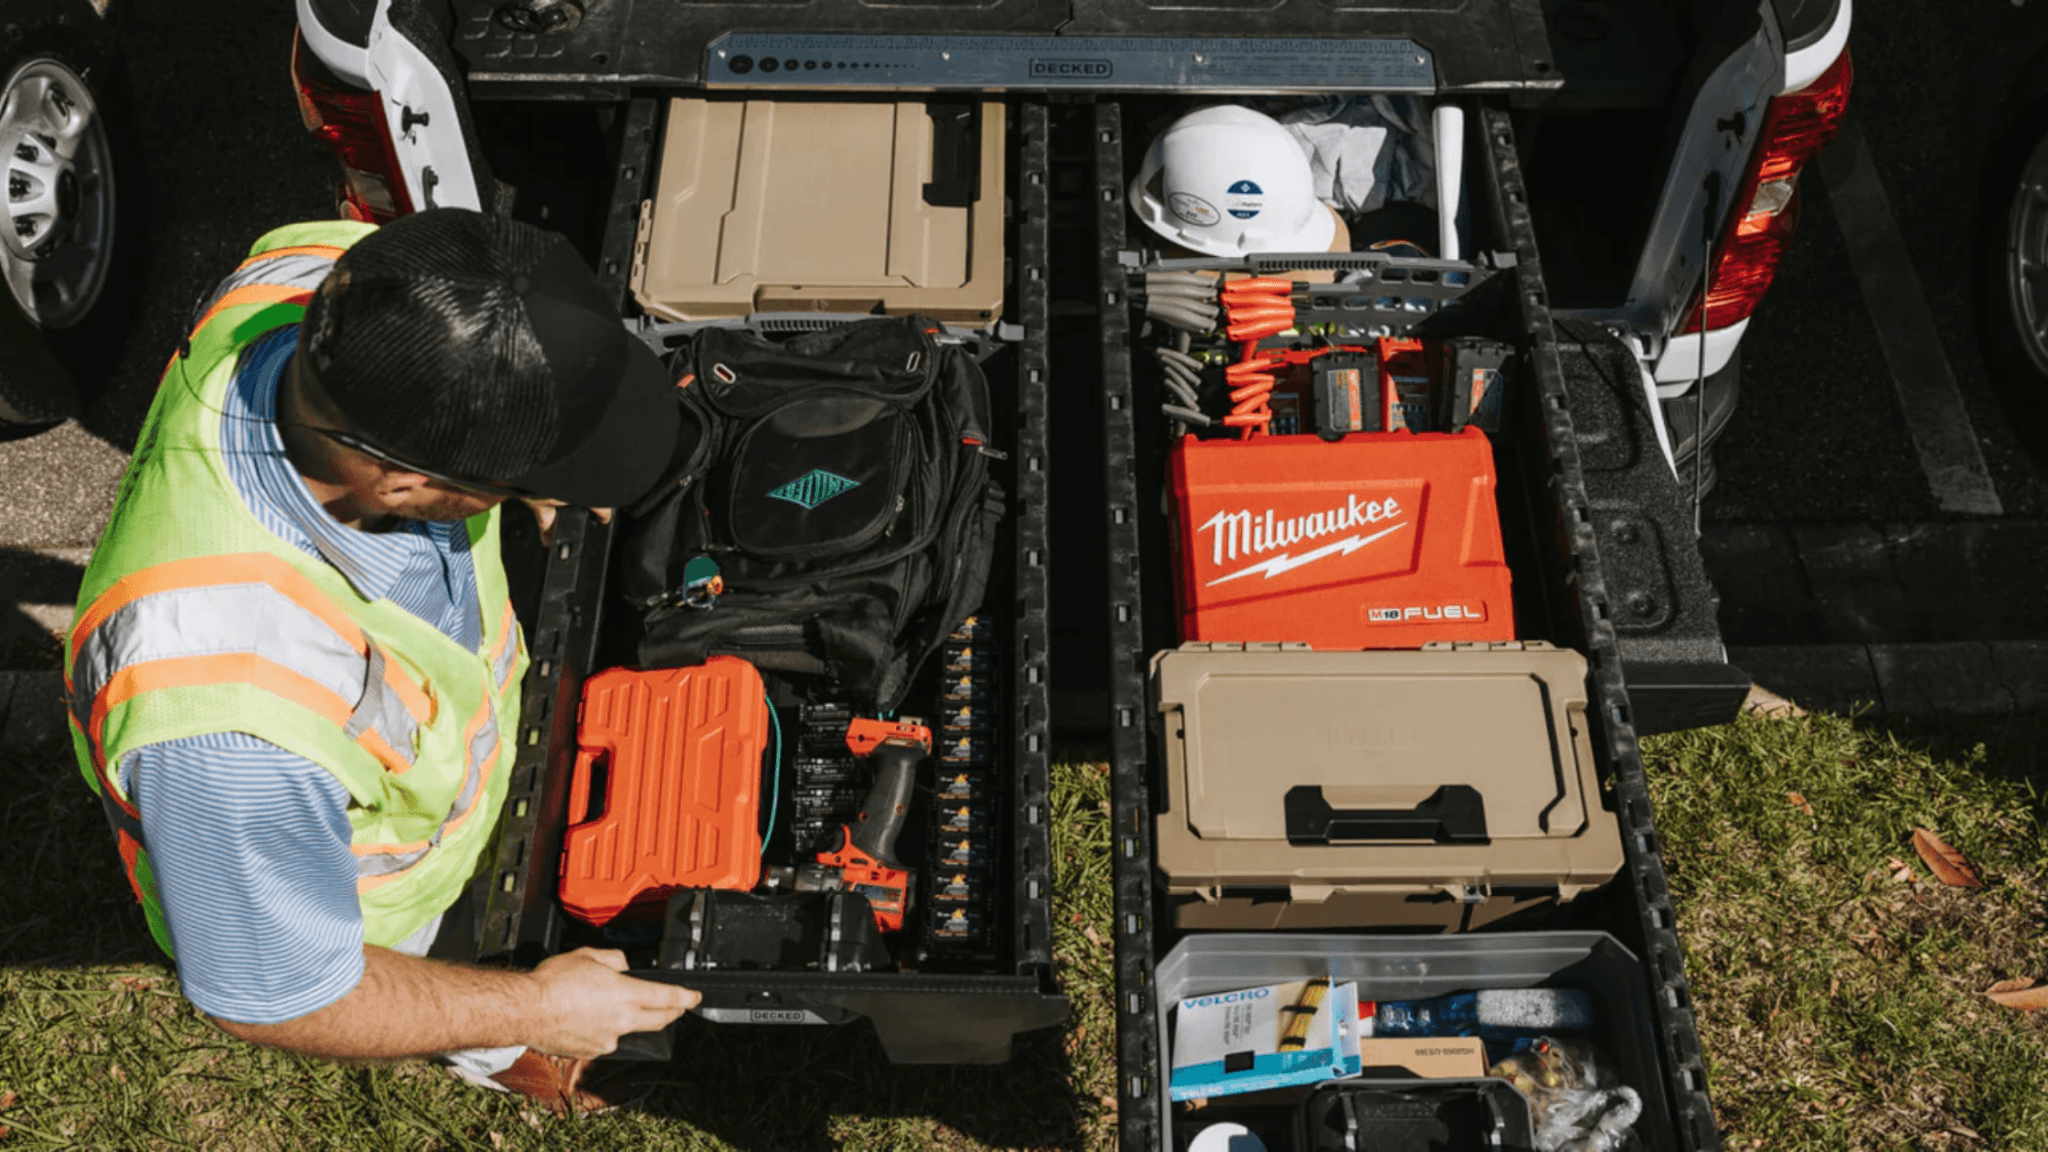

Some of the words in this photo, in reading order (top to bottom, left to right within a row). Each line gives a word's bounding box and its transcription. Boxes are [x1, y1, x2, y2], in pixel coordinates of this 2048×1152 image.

[1034, 63, 1107, 75] DECKED
[1197, 493, 1403, 567] Milwaukee
[1369, 609, 1400, 621] M18
[1403, 605, 1481, 621] FUEL
[1182, 987, 1271, 1010] VELCRO
[753, 1011, 801, 1021] DECKED
